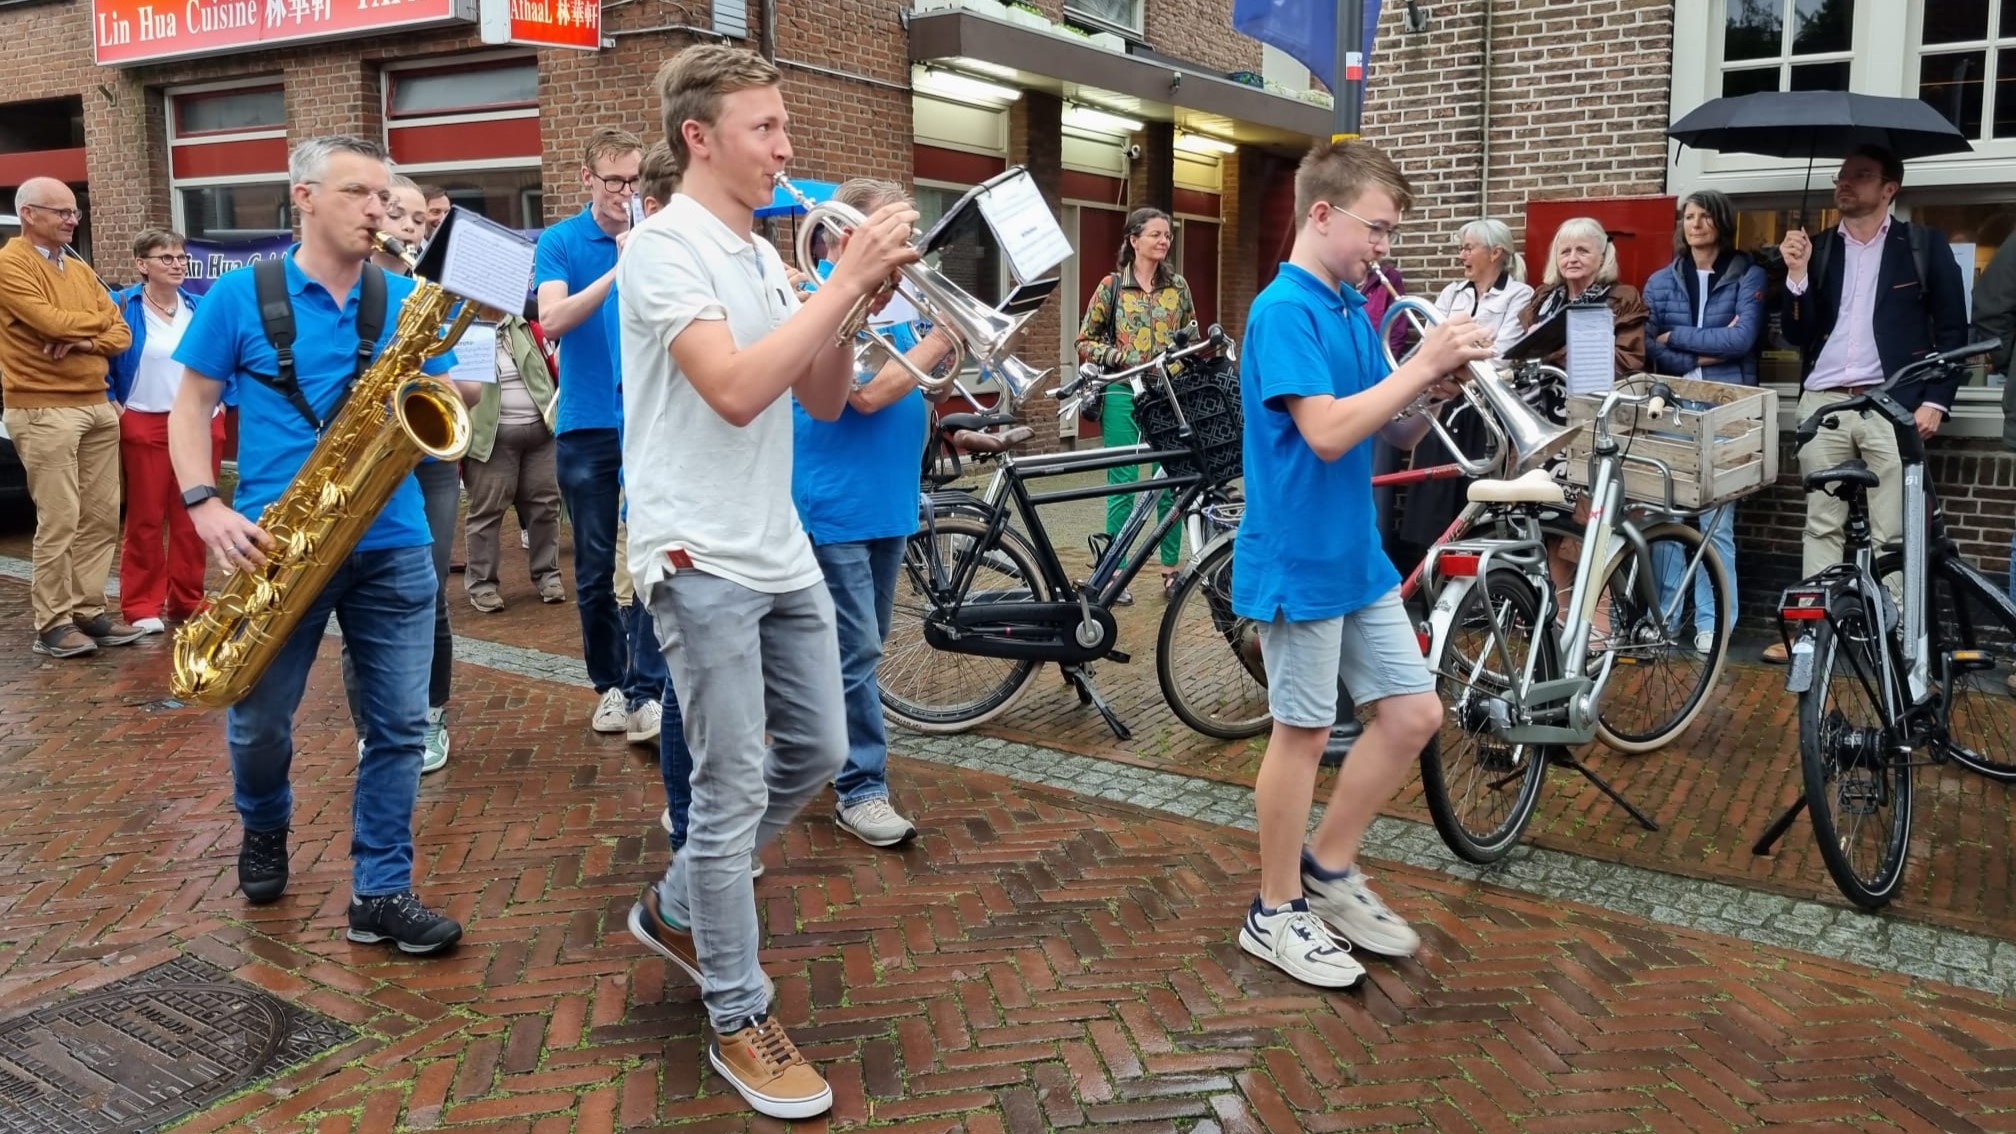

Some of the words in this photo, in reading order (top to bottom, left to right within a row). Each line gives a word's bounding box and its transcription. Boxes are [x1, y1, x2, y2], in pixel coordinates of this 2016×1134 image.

[98, 12, 130, 46] Lin
[137, 6, 177, 41] Hua
[185, 0, 258, 34] Cuisine
